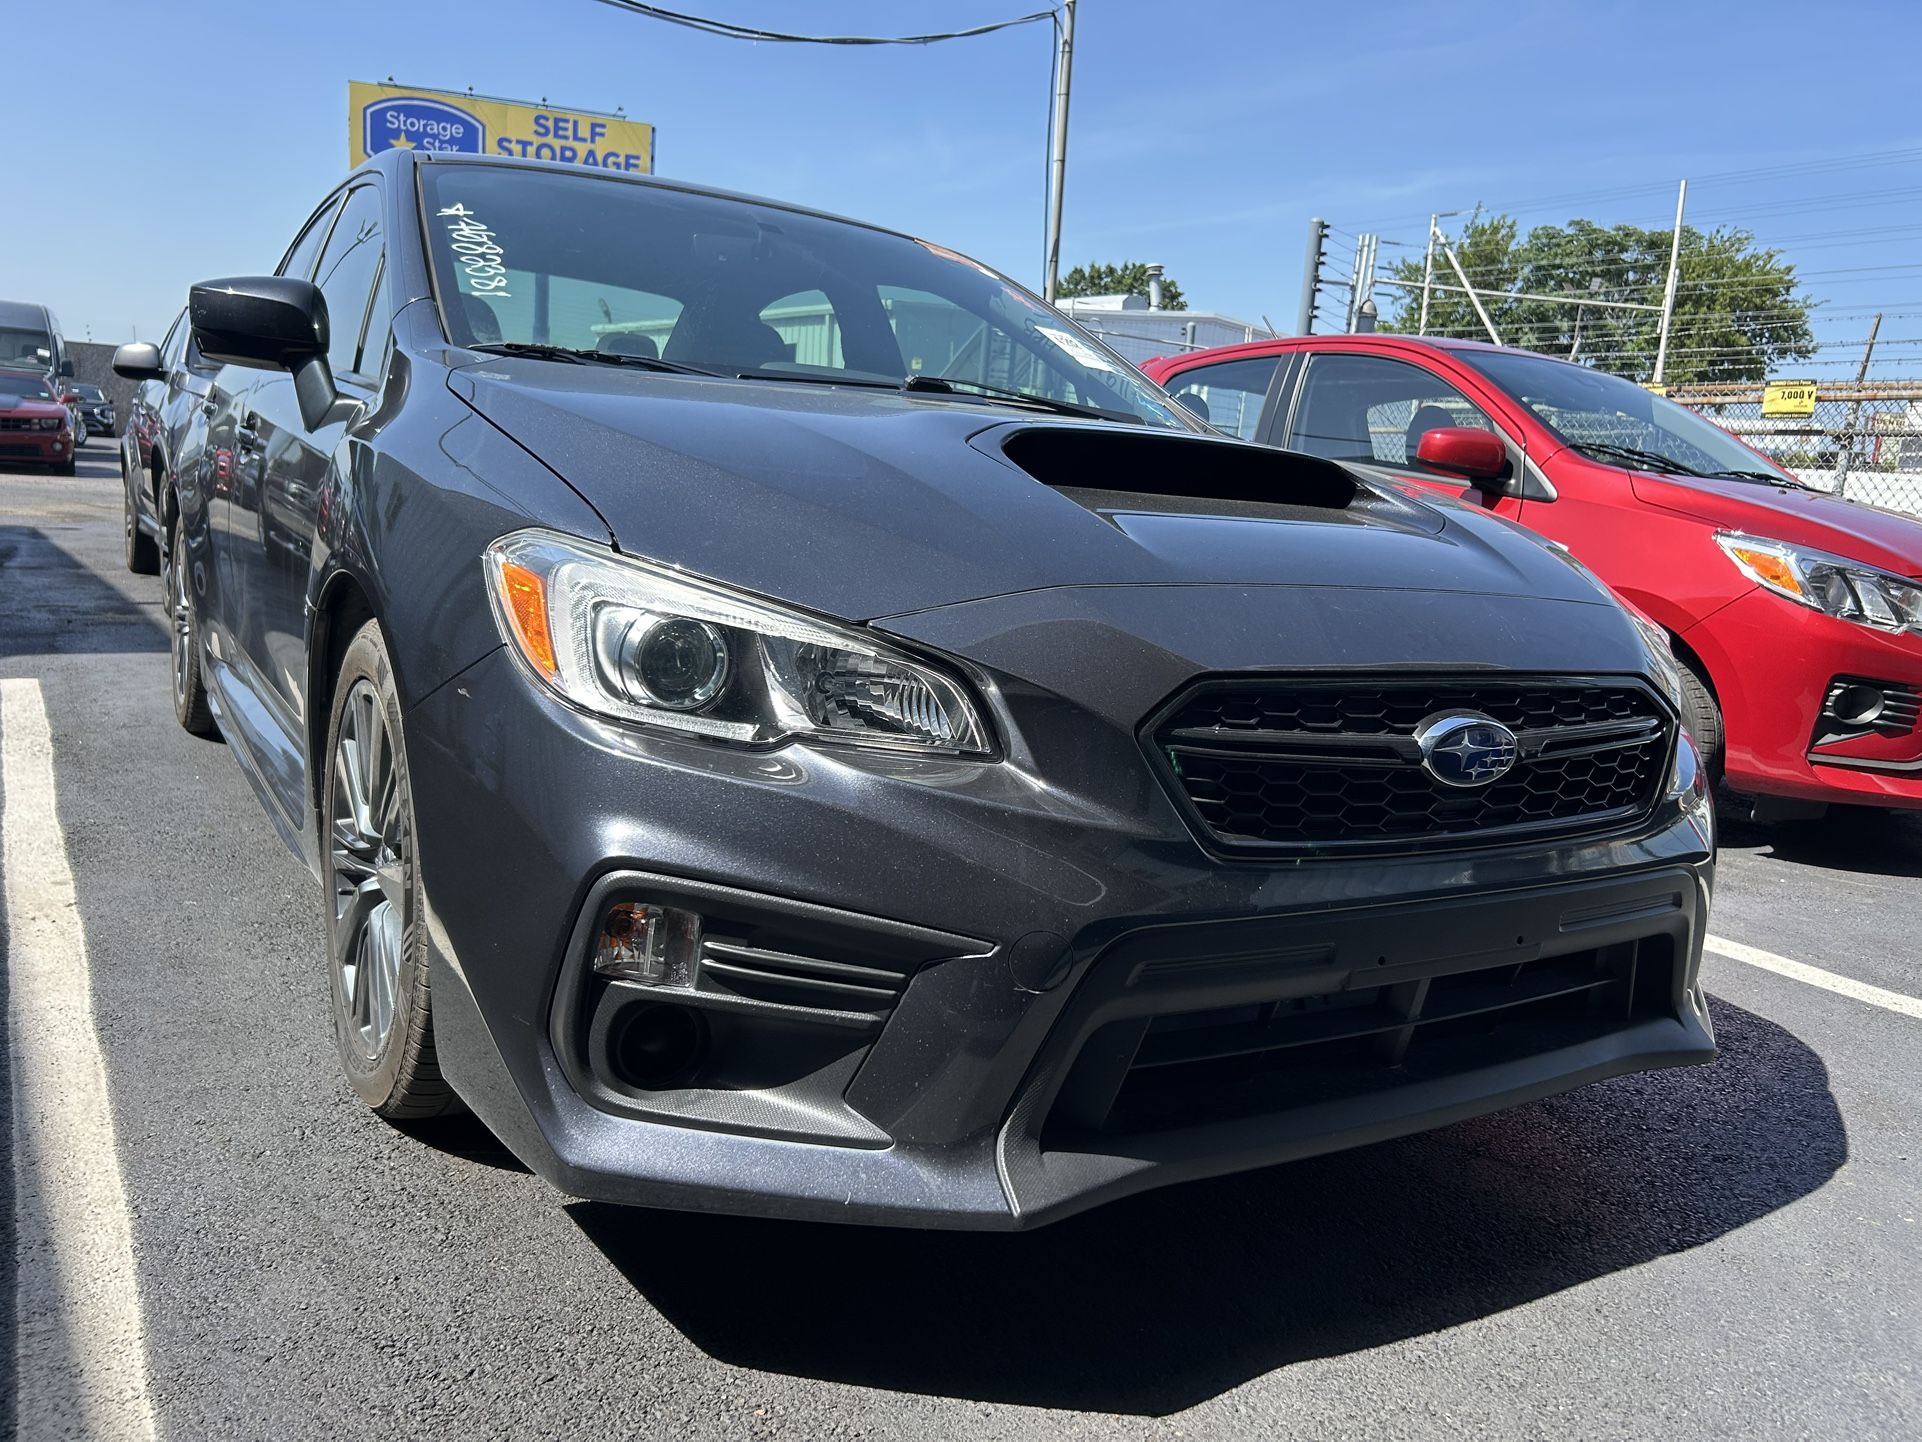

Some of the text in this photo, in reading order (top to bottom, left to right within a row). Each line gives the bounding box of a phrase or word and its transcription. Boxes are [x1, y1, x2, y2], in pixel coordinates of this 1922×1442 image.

[386, 110, 464, 139] Storage
[533, 114, 608, 144] SELF
[496, 137, 641, 171] STORAGE
[1781, 390, 1814, 400] 7,000 V
[398, 751, 412, 889] NEXEN
